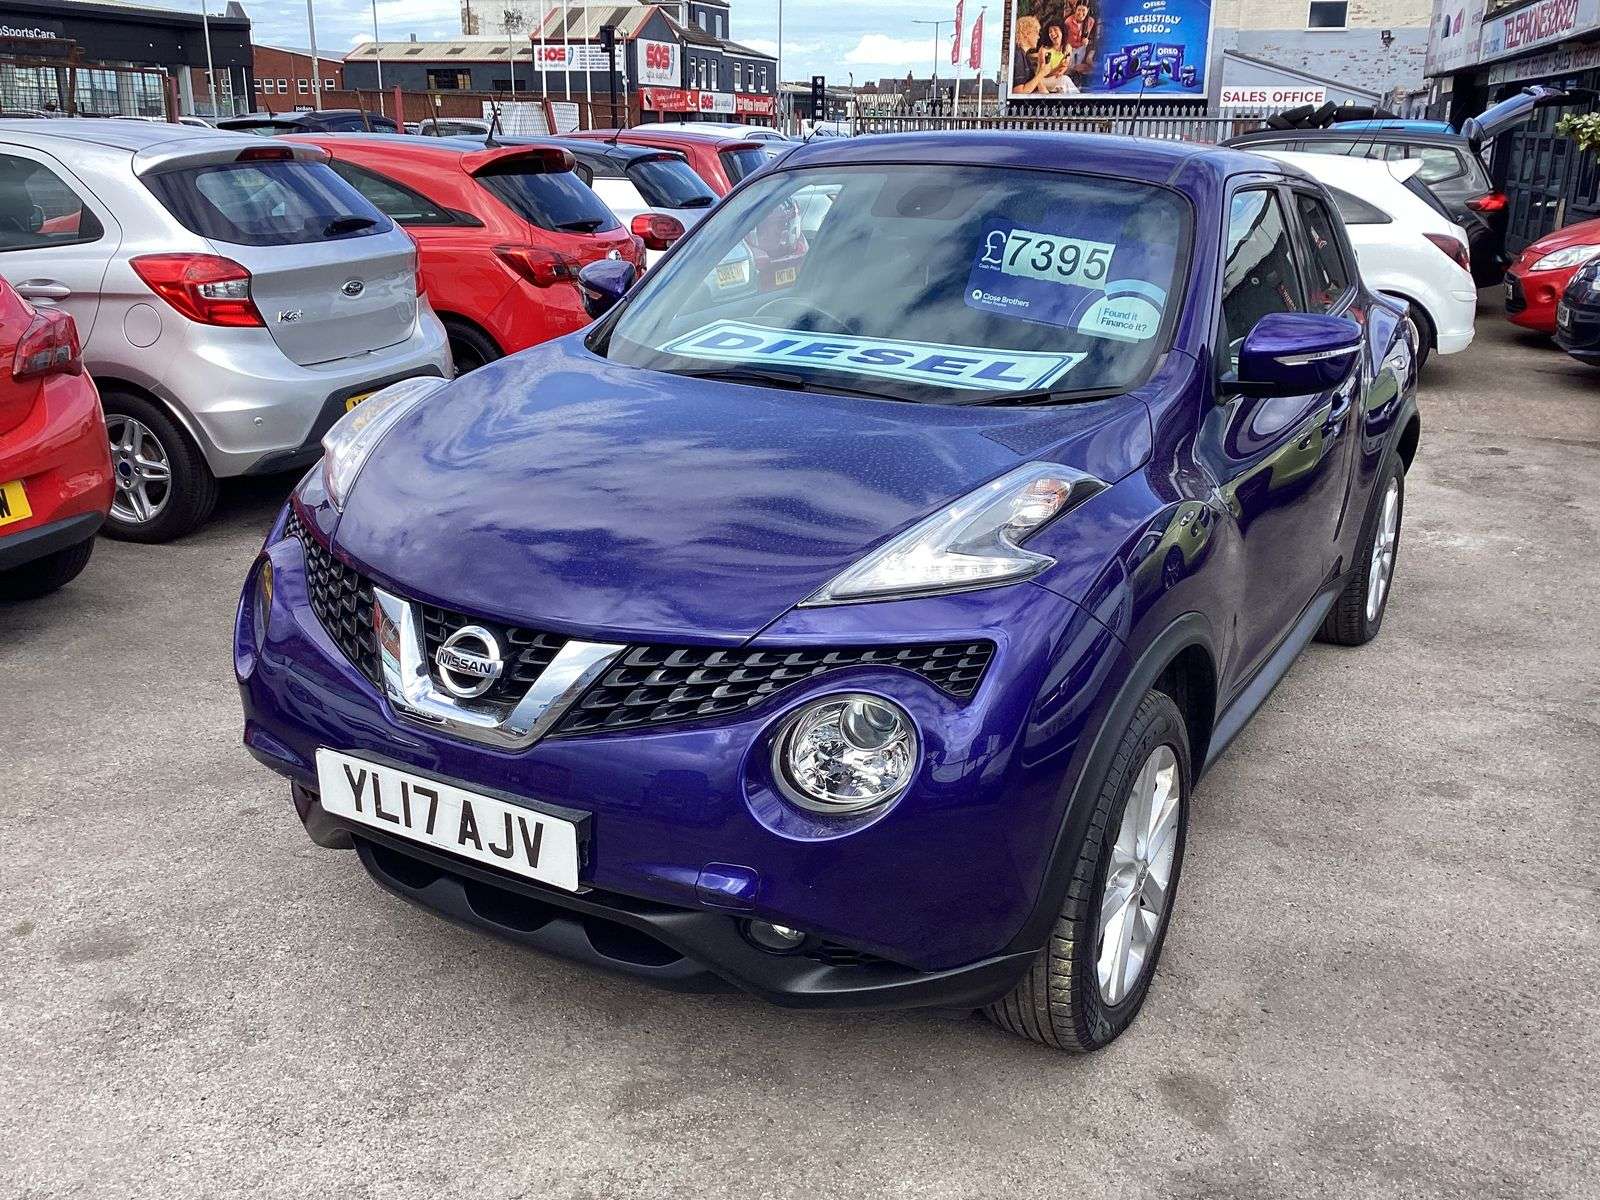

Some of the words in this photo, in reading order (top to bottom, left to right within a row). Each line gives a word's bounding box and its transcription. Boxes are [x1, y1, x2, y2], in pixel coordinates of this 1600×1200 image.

[1124, 14, 1182, 25] IRRESISTIBLY
[1139, 24, 1164, 33] OREO
[646, 43, 670, 69] SOS
[1222, 91, 1267, 103] SALES
[1272, 91, 1324, 103] OFFICE
[981, 230, 1109, 281] £7395
[983, 292, 1002, 302] Close
[1002, 296, 1030, 307] Brothers
[1103, 307, 1129, 320] Found
[1131, 311, 1138, 321] it
[1100, 316, 1133, 330] Finance
[1135, 322, 1147, 332] it?
[691, 331, 1026, 383] DIESEL
[439, 651, 492, 674] NISSAN
[343, 763, 438, 835] YL17
[457, 800, 544, 868] AJV
